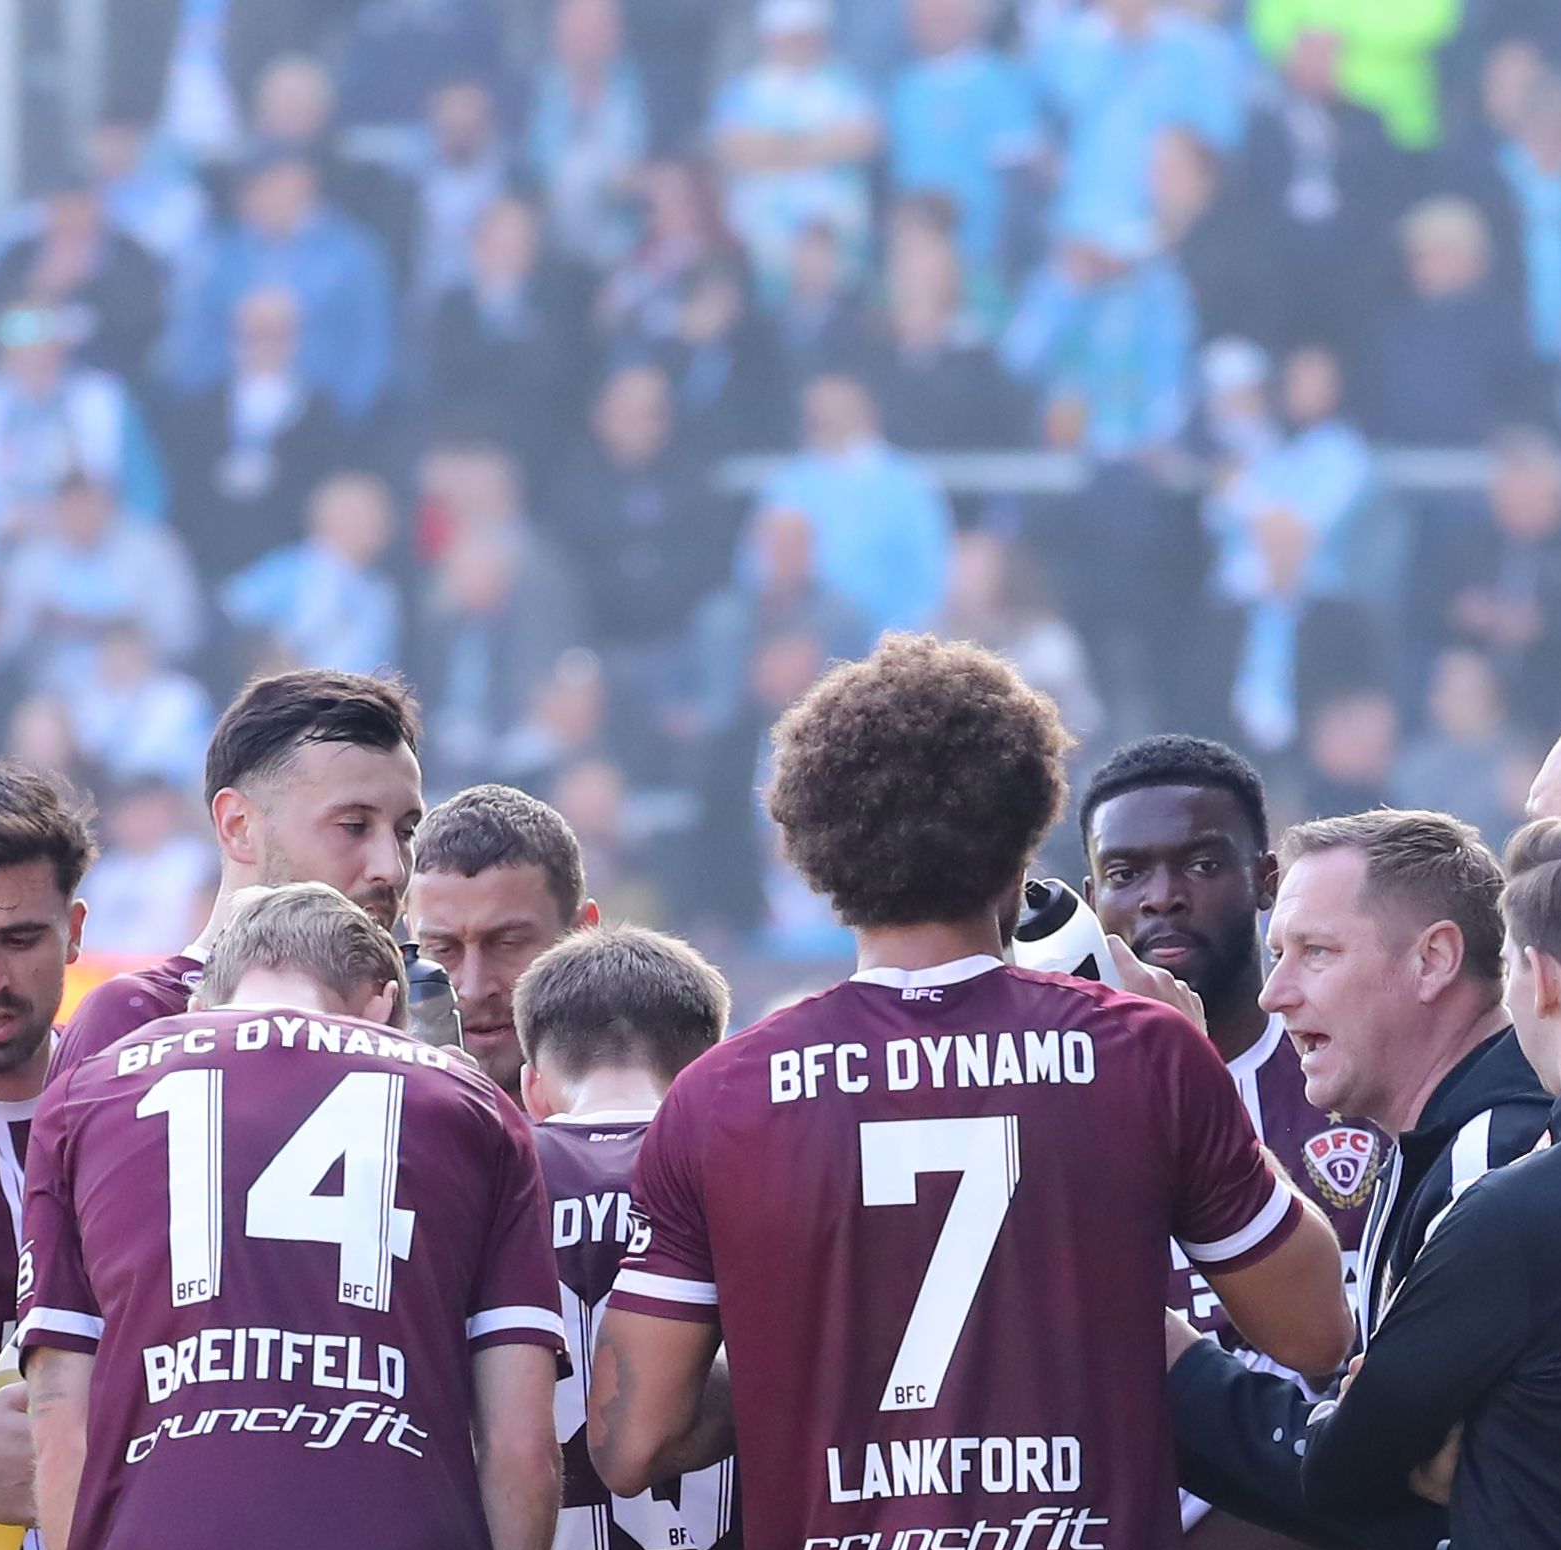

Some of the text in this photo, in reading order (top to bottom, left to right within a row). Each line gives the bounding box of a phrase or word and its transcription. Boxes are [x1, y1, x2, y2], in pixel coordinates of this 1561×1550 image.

[901, 987, 942, 1003] BFC
[117, 1016, 449, 1077] BFC DYNAMO
[770, 1030, 1096, 1103] BFC DYNAMO
[1308, 1131, 1369, 1159] BFC
[136, 1068, 415, 1313] 14
[553, 1192, 633, 1249] DYN
[176, 1279, 208, 1302] BFC
[342, 1282, 374, 1305] BFC
[859, 1114, 1021, 1412] 7
[143, 1327, 406, 1404] BREITFELD
[894, 1384, 927, 1405] BFC
[125, 1400, 430, 1465] crunchfit
[827, 1435, 1082, 1503] LANKFORD
